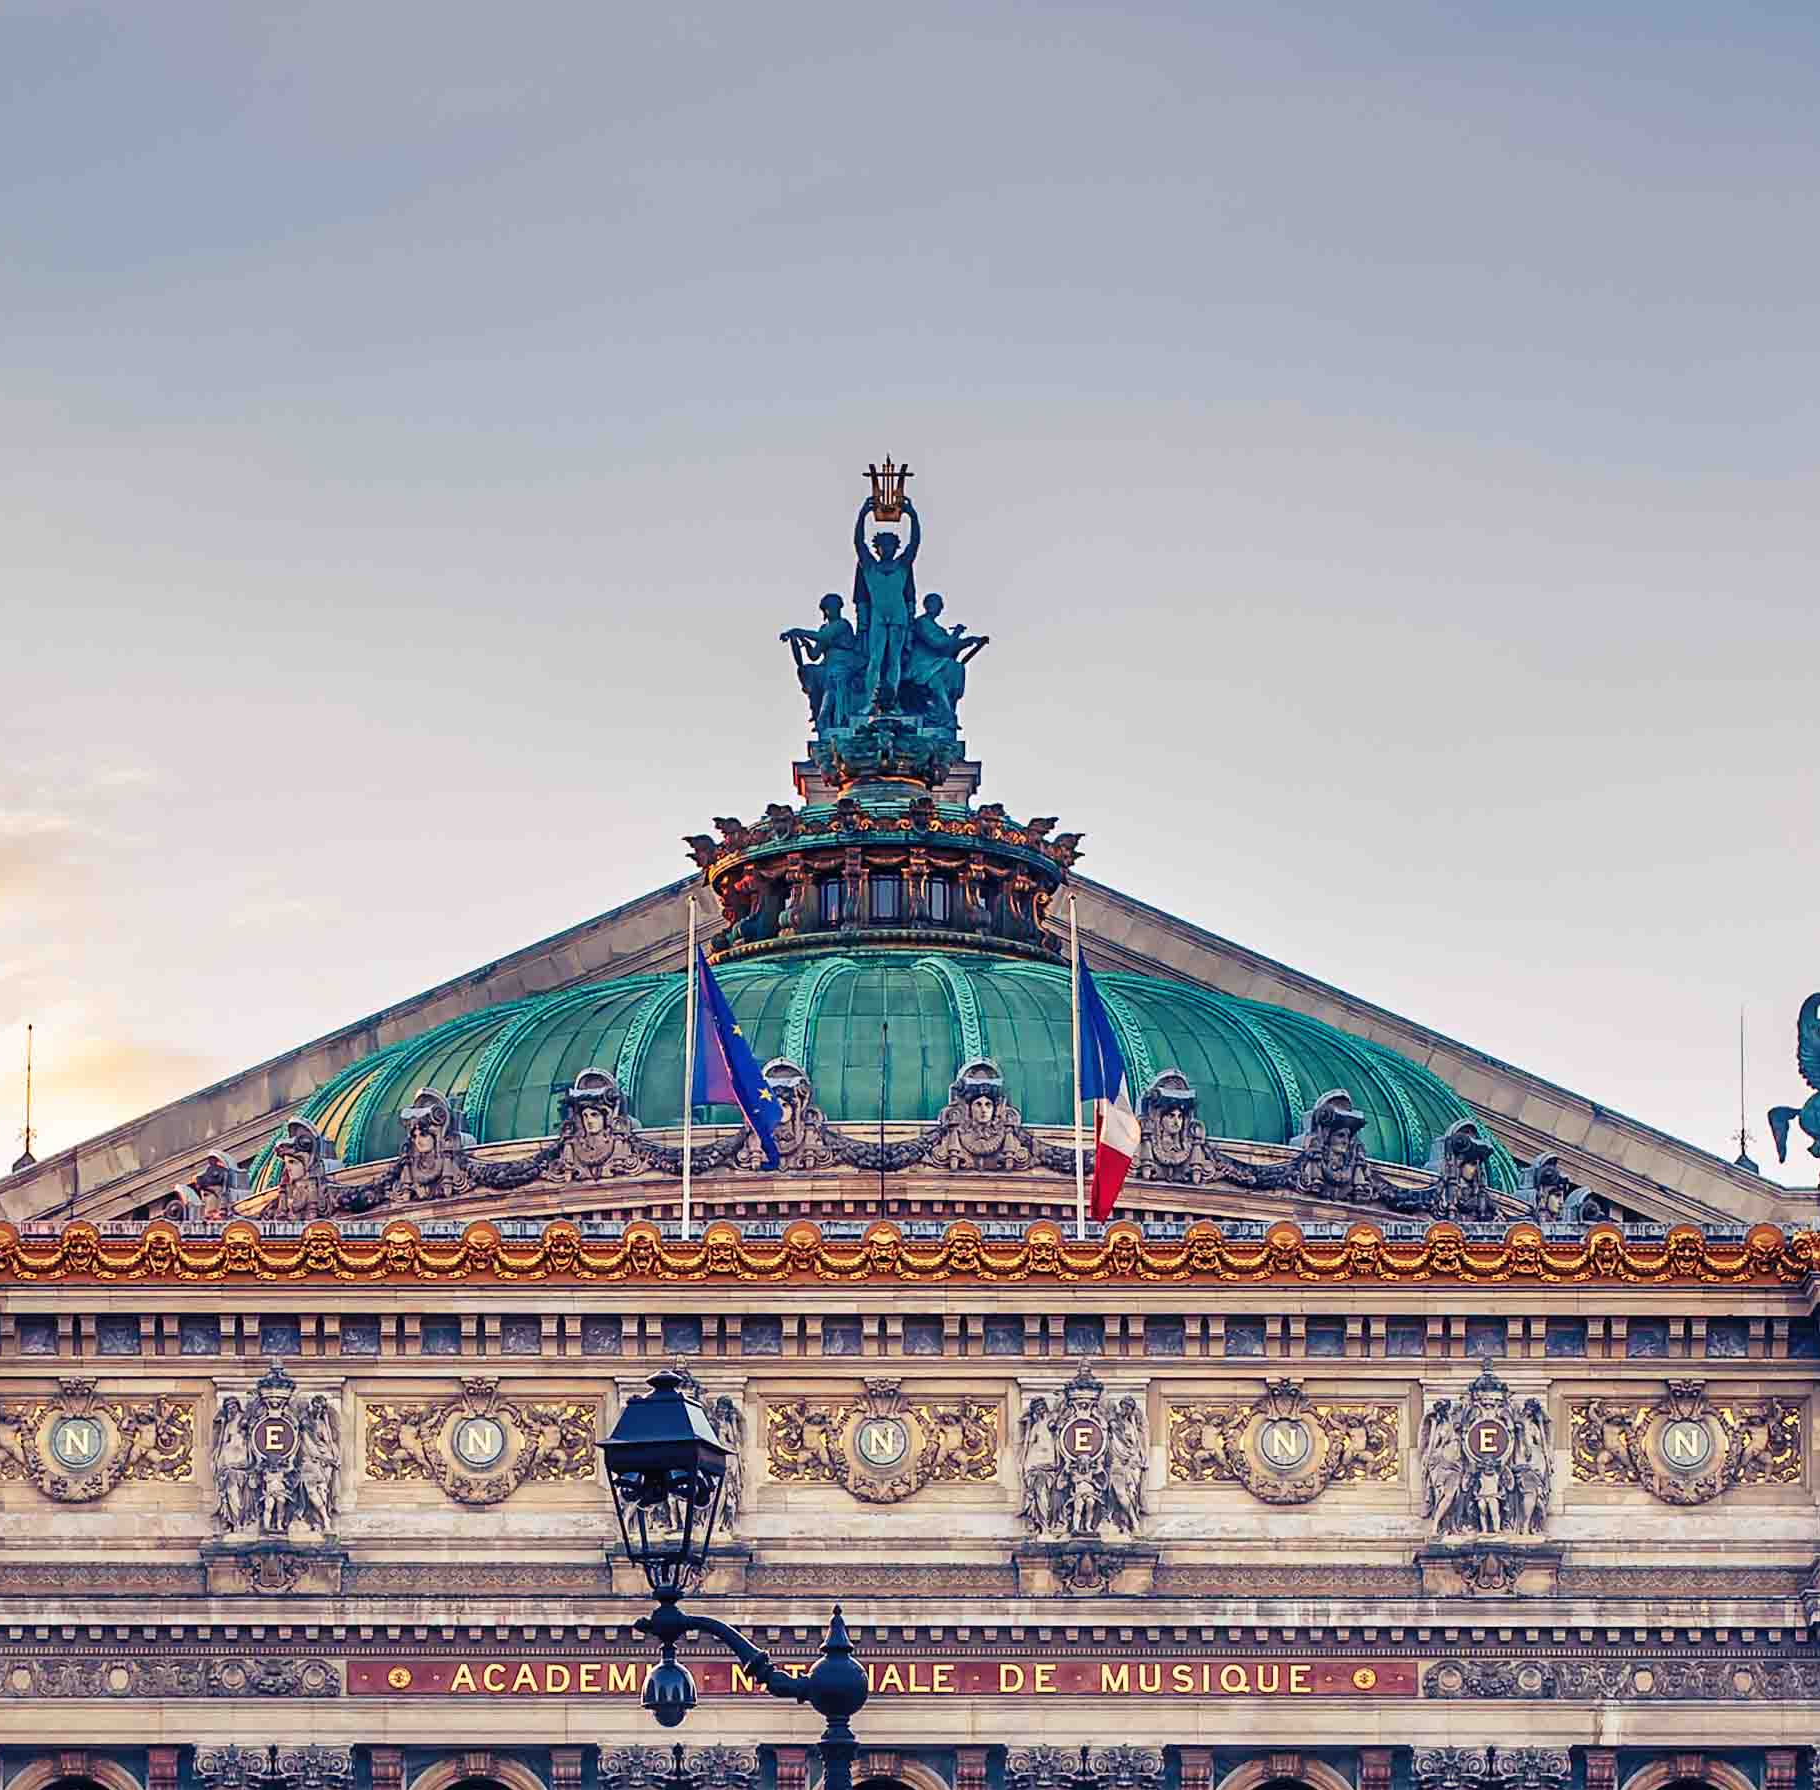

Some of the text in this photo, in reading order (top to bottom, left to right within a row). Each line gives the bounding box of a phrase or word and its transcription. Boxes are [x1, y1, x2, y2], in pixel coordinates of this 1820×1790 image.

[63, 1427, 90, 1455] N
[265, 1425, 285, 1450] E
[467, 1427, 492, 1454] N
[869, 1428, 895, 1456] N
[1074, 1427, 1094, 1452] E
[1273, 1428, 1297, 1457] N
[1479, 1428, 1498, 1453] E
[1673, 1430, 1698, 1457] N
[450, 1663, 1312, 1694] ACADEM NTALE DE MUSIQUE
